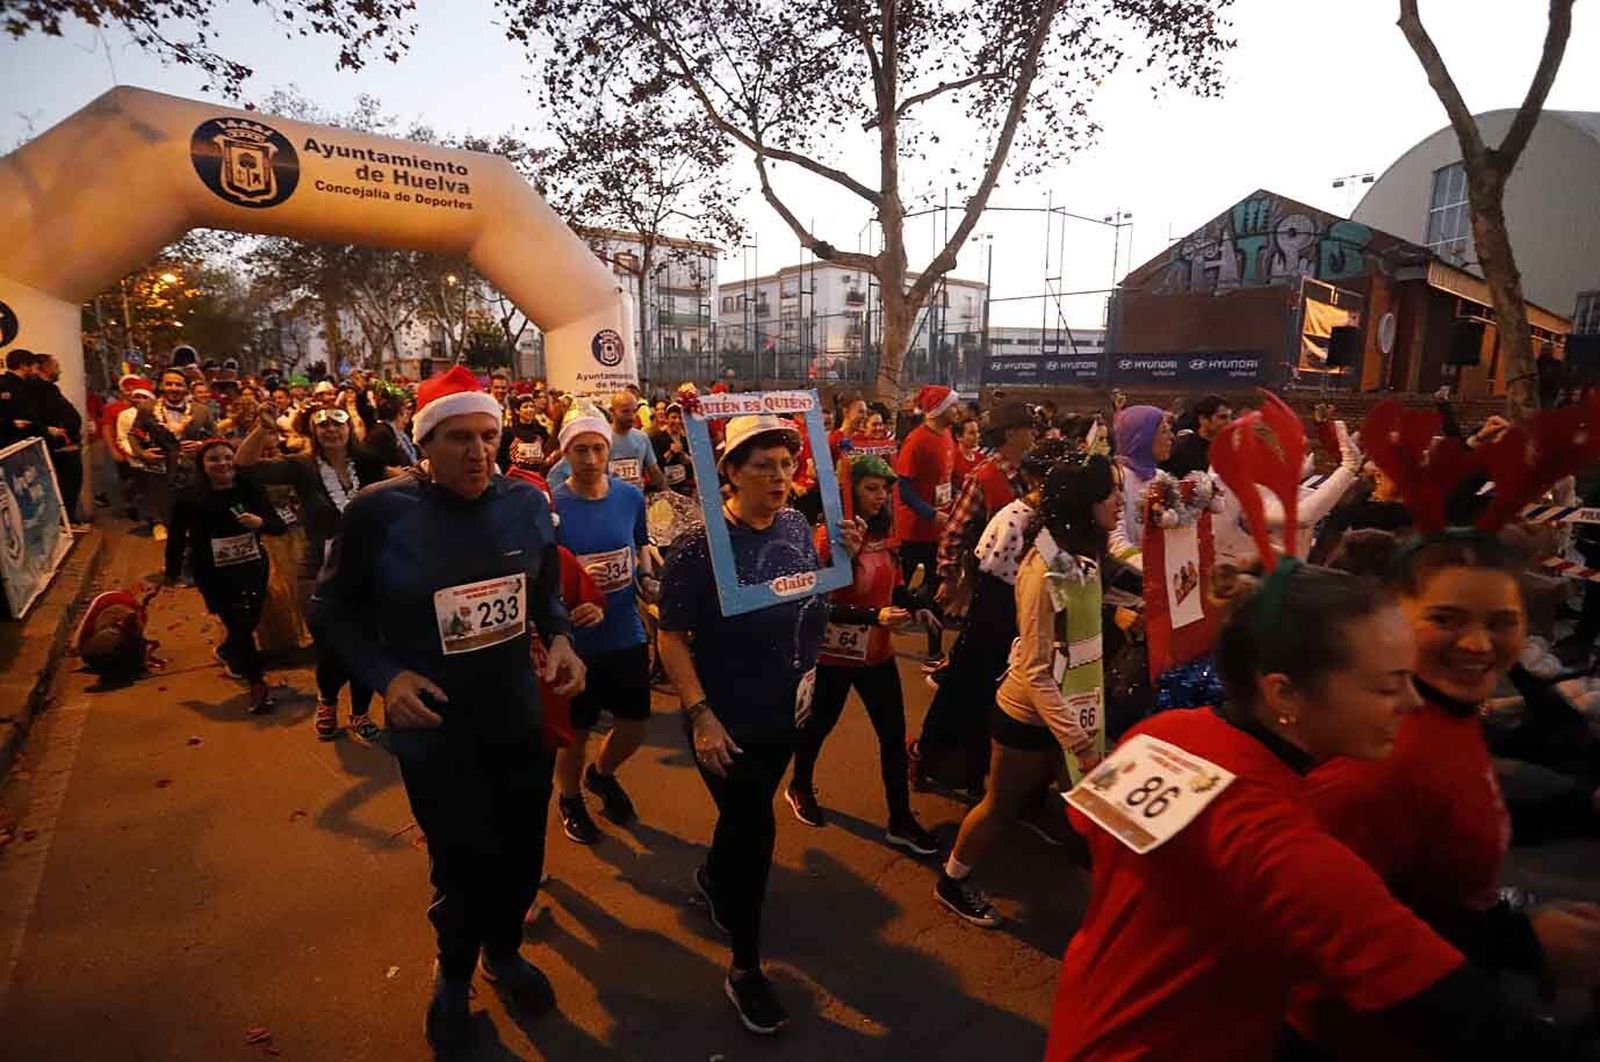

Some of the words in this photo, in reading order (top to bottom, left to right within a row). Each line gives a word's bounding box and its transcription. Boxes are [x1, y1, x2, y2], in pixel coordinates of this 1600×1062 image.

[304, 138, 468, 176] Ayuntamiento
[356, 165, 384, 183] de
[393, 168, 470, 195] Huelva
[394, 191, 411, 203] de
[415, 193, 473, 210] Deportes
[1004, 361, 1037, 370] HYUNDAI
[1061, 361, 1098, 370] HYUNDAI
[1134, 360, 1178, 369] HYUNDAI
[1209, 360, 1259, 369] HYUNDAI
[743, 400, 760, 412] ES
[774, 575, 815, 592] Claire
[477, 595, 519, 628] 233
[839, 631, 859, 646] 64
[1080, 707, 1096, 729] 66
[1127, 776, 1180, 818] 86
